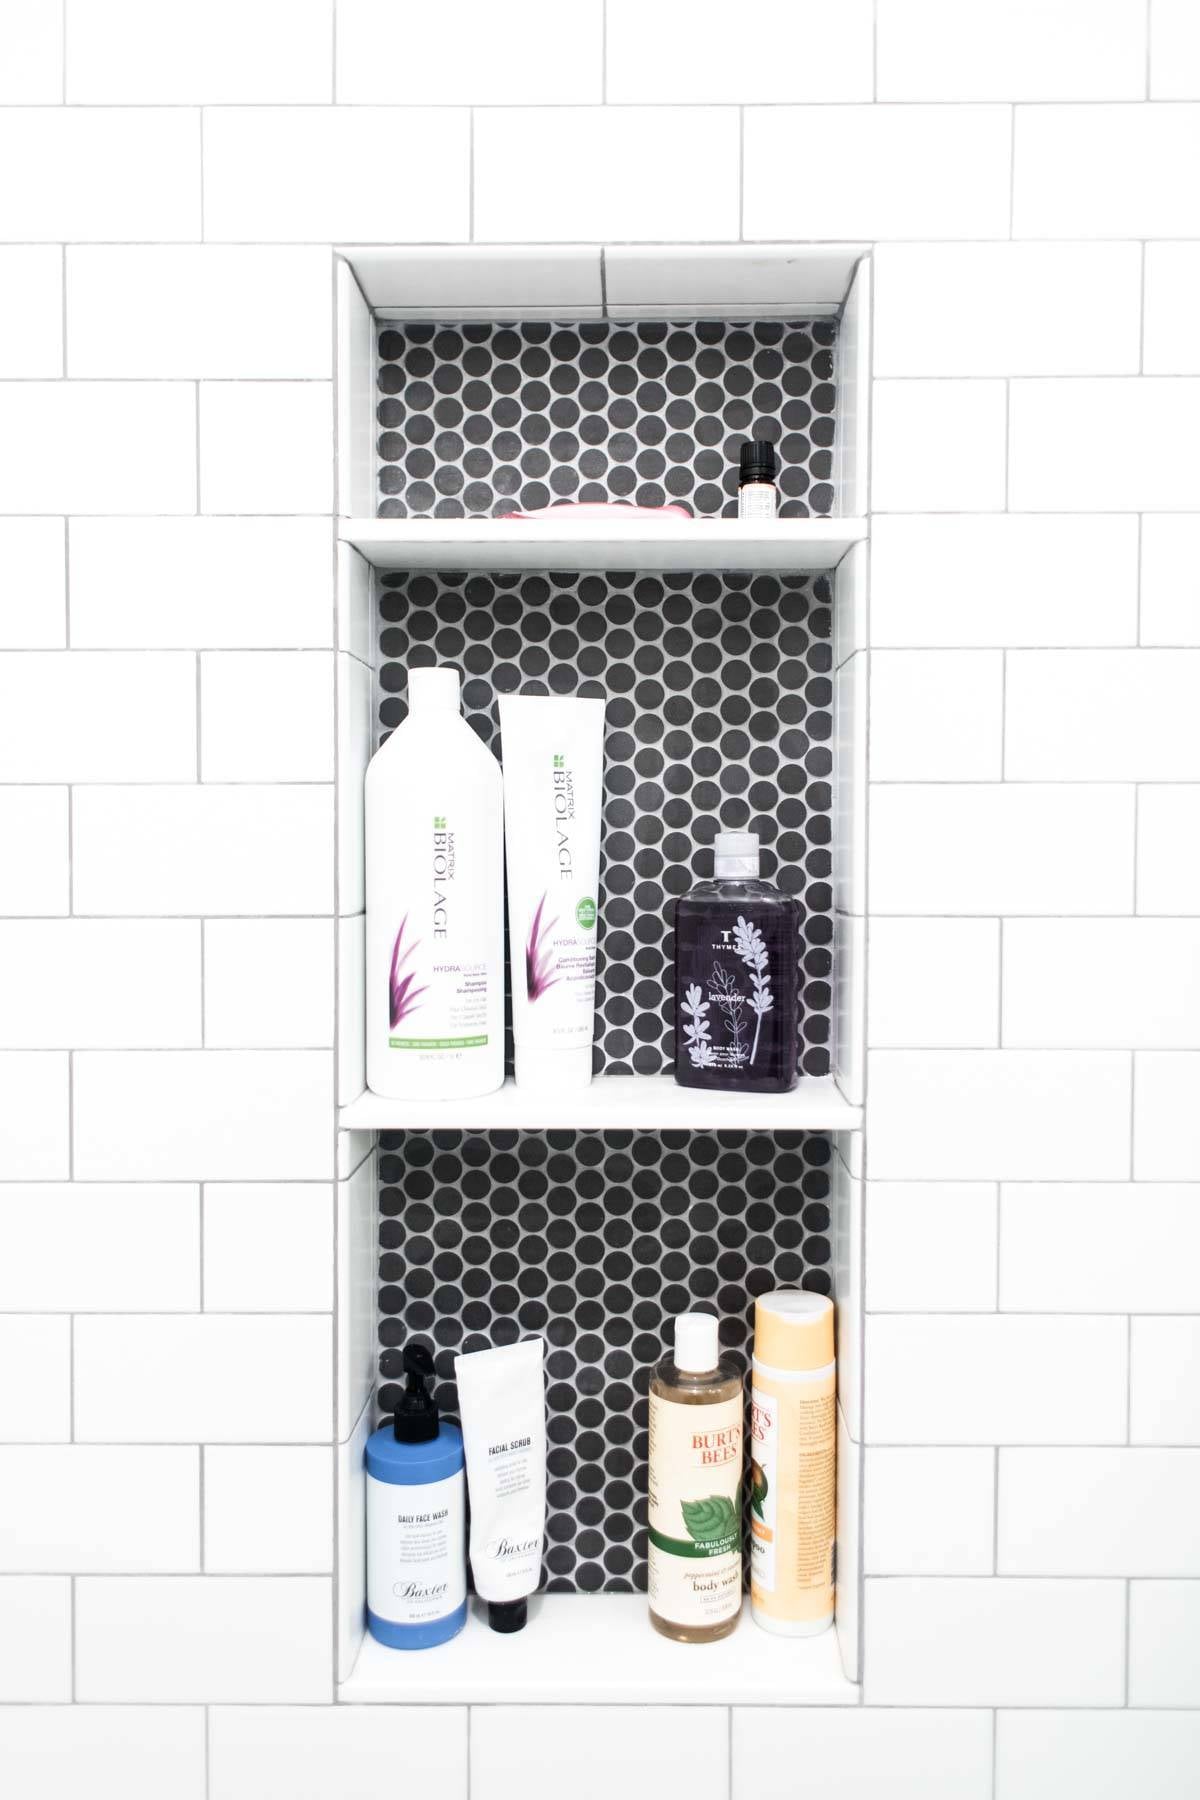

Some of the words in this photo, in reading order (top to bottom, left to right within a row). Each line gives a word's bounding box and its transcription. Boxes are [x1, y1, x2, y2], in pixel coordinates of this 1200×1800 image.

[565, 770, 576, 820] MATRIX
[552, 770, 574, 881] BIOLAGE
[447, 832, 455, 880] MATRIX
[433, 832, 448, 940] BIOLAGE
[720, 931, 732, 943] T
[708, 991, 746, 1002] lavender
[488, 1443, 509, 1456] FACIAL
[510, 1437, 531, 1450] SCRUB
[702, 1443, 738, 1464] BEES
[398, 1515, 414, 1523] DAILY
[416, 1514, 431, 1523] FACE
[432, 1509, 449, 1520] WASH
[487, 1537, 540, 1560] Baxter
[694, 1533, 738, 1550] FABULOUSLY
[709, 1544, 732, 1556] FRESH
[393, 1580, 448, 1599] Baxter
[693, 1579, 719, 1592] body
